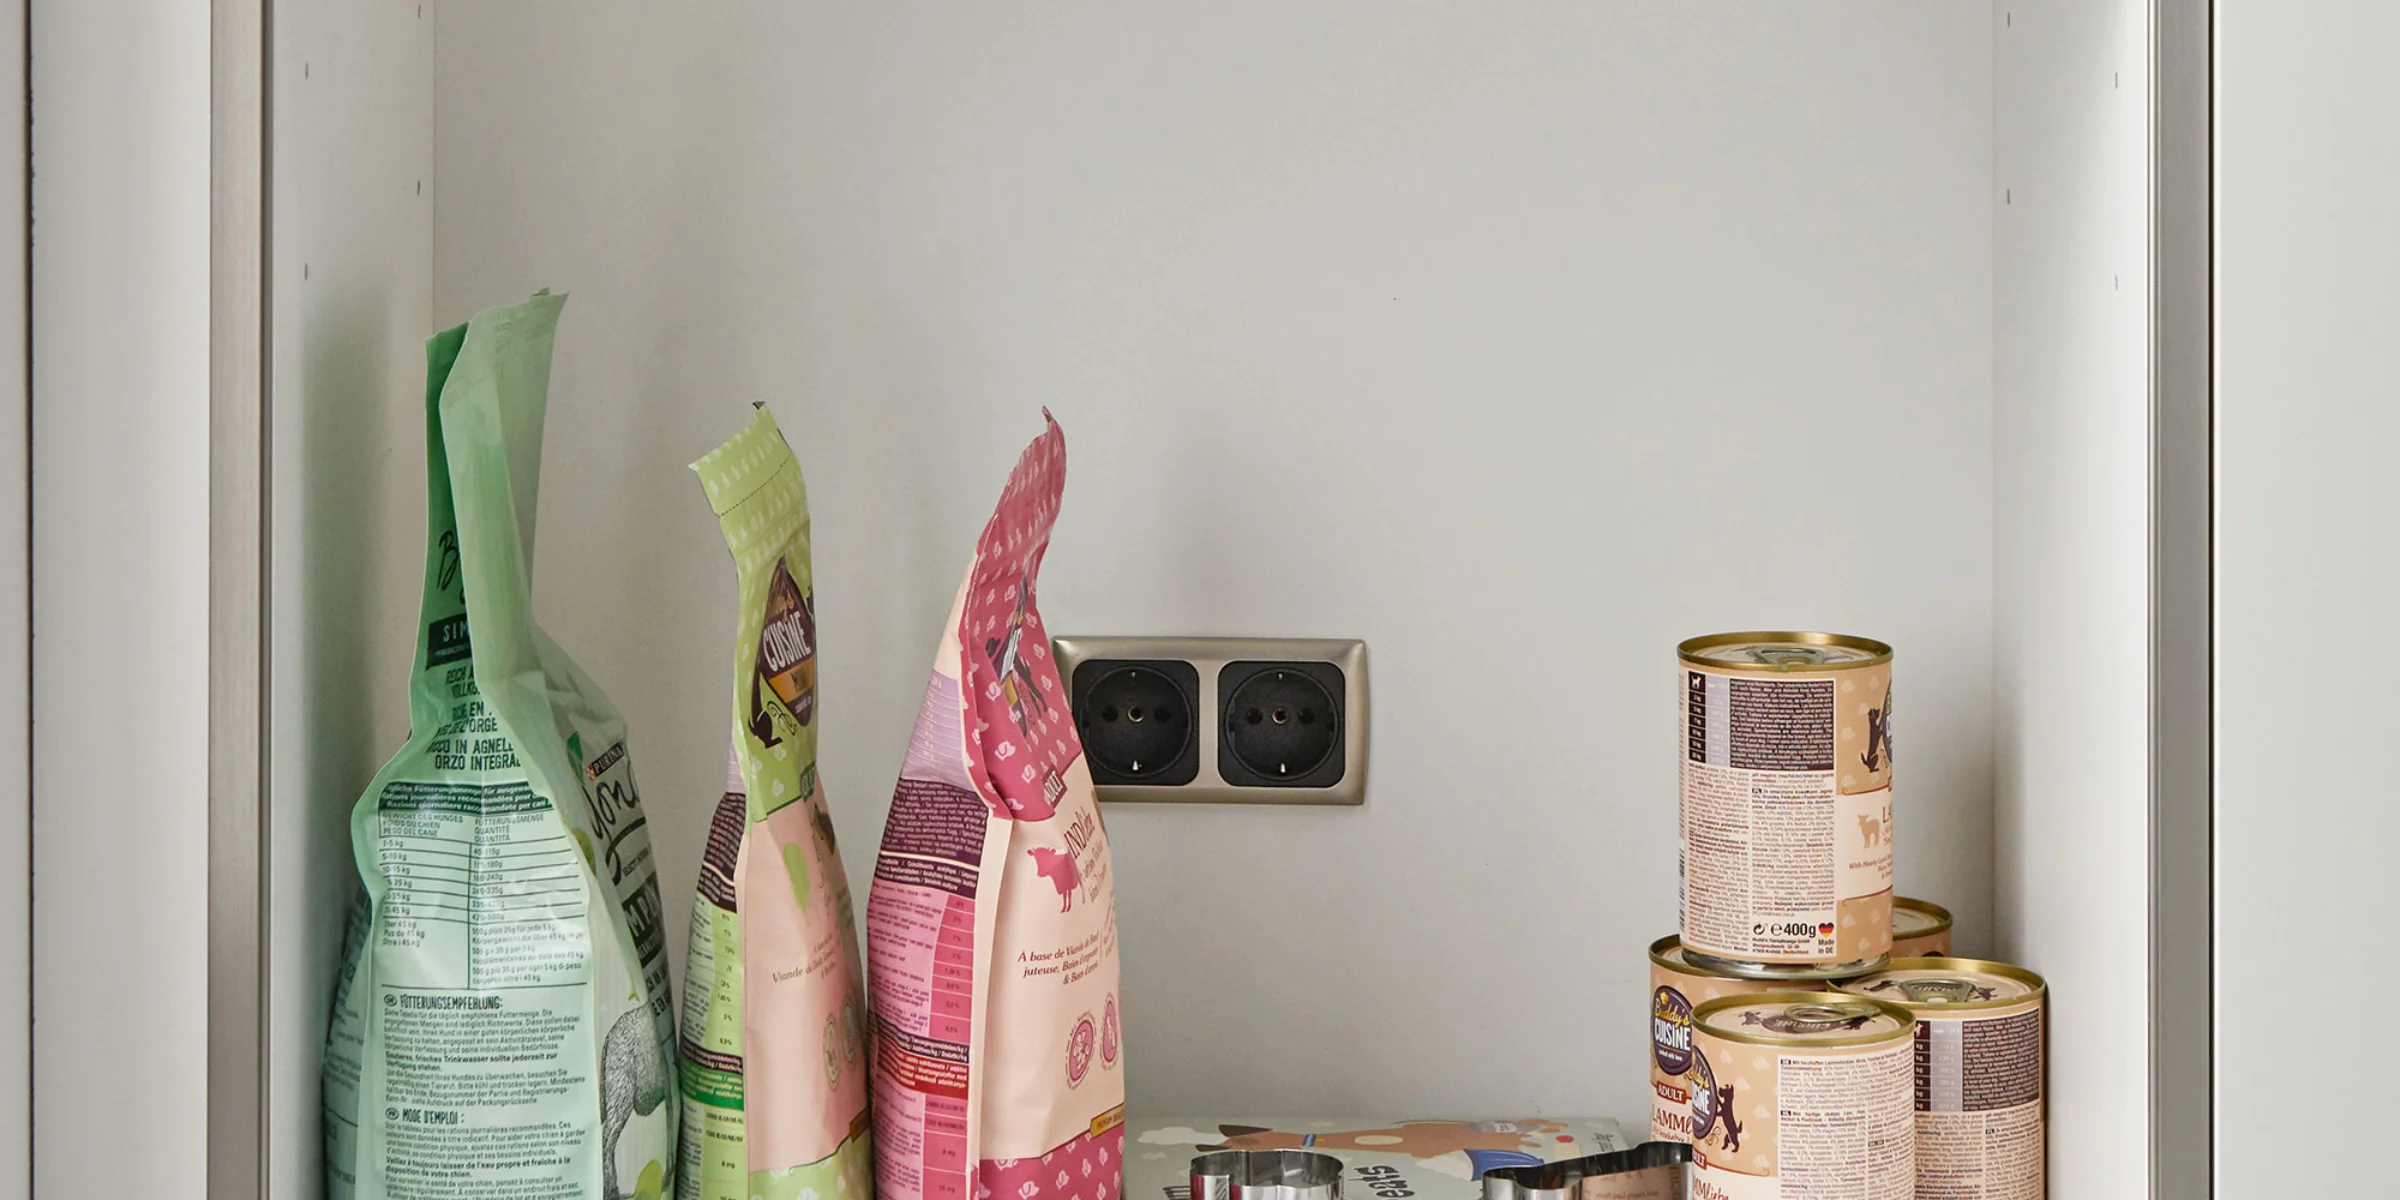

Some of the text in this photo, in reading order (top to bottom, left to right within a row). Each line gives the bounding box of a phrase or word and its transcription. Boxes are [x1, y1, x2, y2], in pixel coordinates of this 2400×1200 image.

[762, 610, 812, 673] CUISINE
[469, 701, 484, 716] EN
[455, 738, 469, 754] IN
[434, 754, 467, 771] ORZO
[418, 821, 441, 829] CHIEN
[417, 829, 438, 837] CANE
[399, 853, 407, 861] kg
[402, 867, 410, 876] kg
[404, 880, 412, 889] kg
[402, 893, 410, 902] kg
[402, 907, 410, 916] kg
[1783, 921, 1817, 938] 400g
[416, 930, 425, 940] kg
[1030, 951, 1053, 962] base
[1054, 948, 1065, 959] de
[550, 963, 558, 972] kg
[566, 963, 583, 971] peso
[1022, 966, 1060, 978] juteuse,
[524, 973, 541, 983] 45 kg
[772, 966, 804, 983] Viande
[542, 1008, 553, 1016] Die
[1655, 998, 1691, 1029] Buddy's
[1655, 1018, 1692, 1051] CUISINE
[415, 1053, 443, 1063] frisches
[444, 1054, 489, 1063] Trinkwasser
[490, 1054, 511, 1062] sollte
[512, 1053, 545, 1063] jederzeit
[558, 1068, 568, 1076] Sie
[1658, 1084, 1685, 1102] ADULT
[402, 1108, 459, 1125] MODE D'EMPLOI
[558, 1121, 571, 1129] Ces
[491, 1134, 507, 1142] Pour
[565, 1129, 586, 1139] garder
[440, 1161, 465, 1169] laisser
[466, 1161, 476, 1169] de
[476, 1161, 495, 1169] l'eau
[495, 1161, 520, 1170] propre
[421, 1169, 472, 1178] de votre chien.
